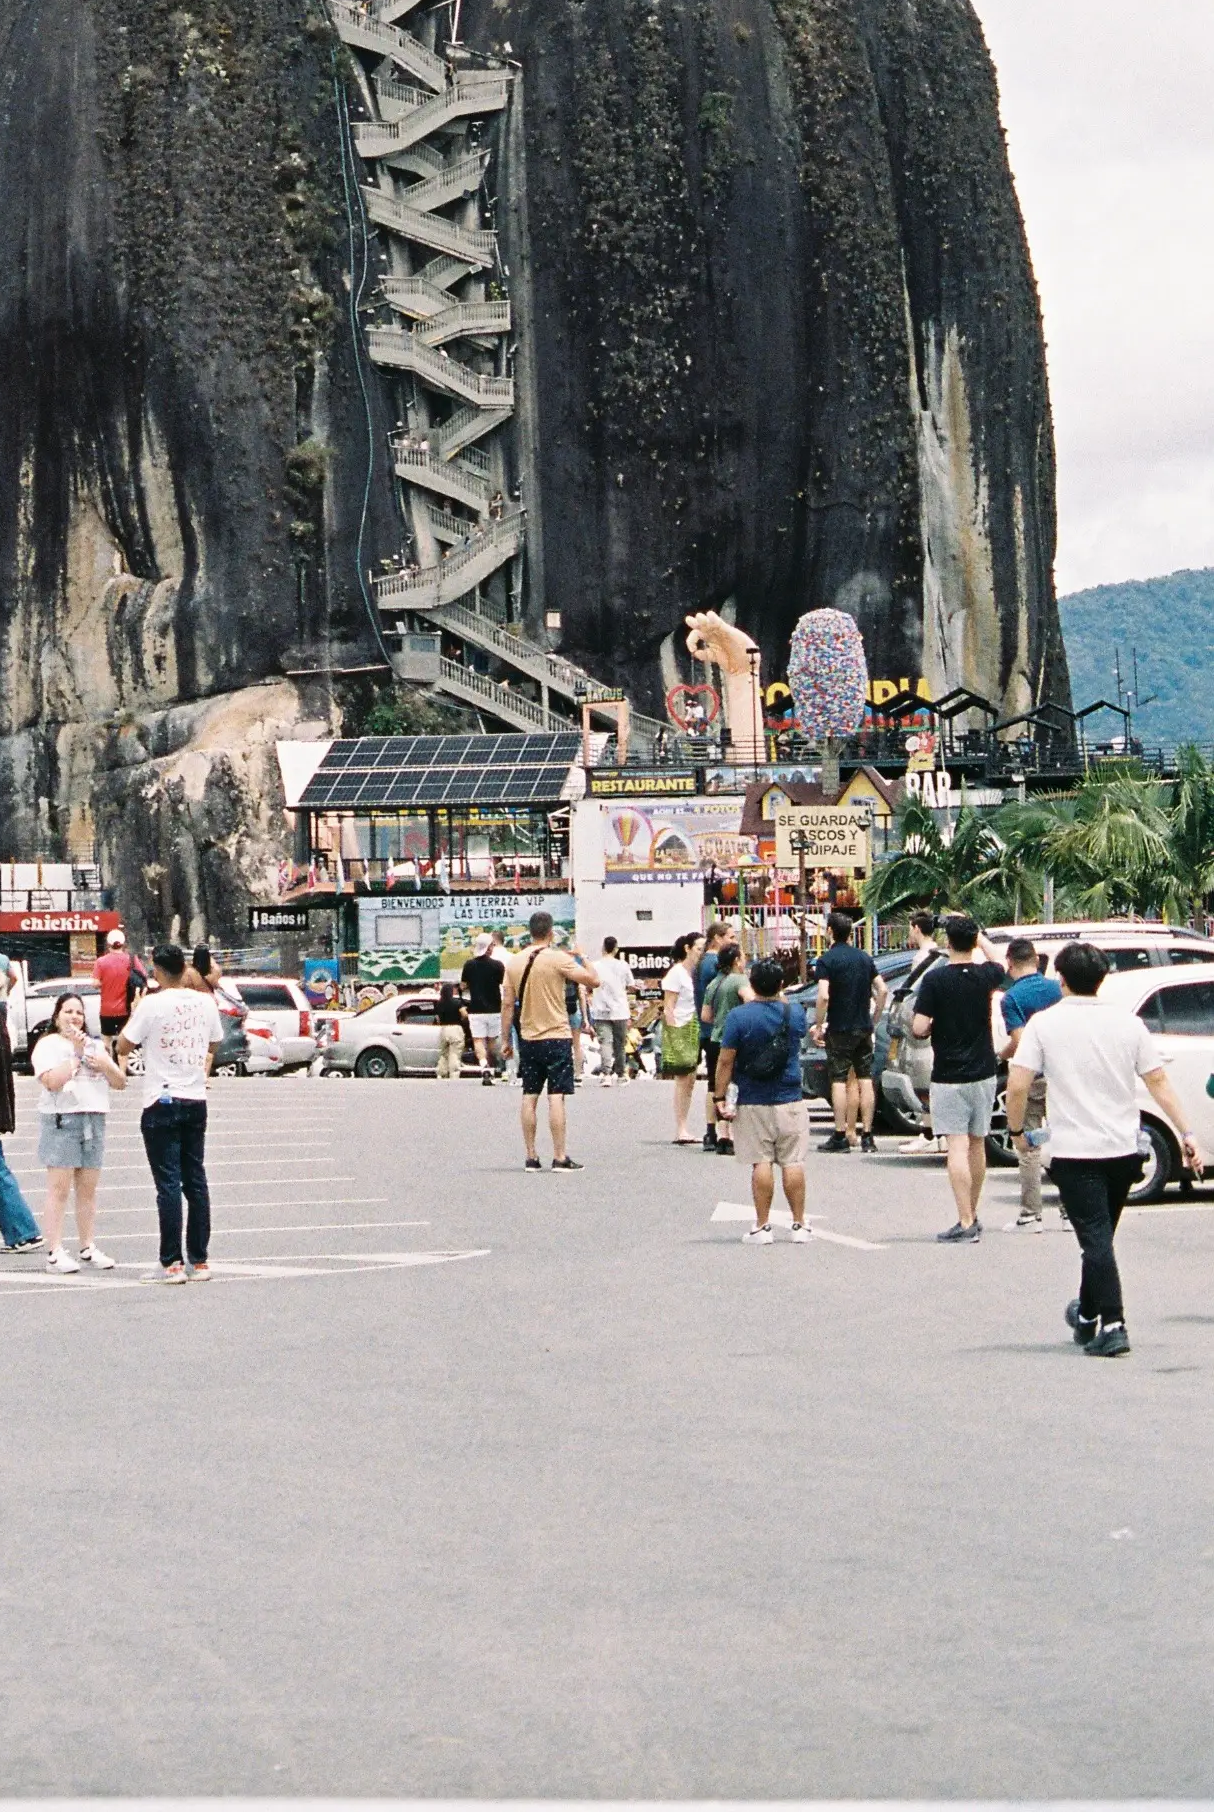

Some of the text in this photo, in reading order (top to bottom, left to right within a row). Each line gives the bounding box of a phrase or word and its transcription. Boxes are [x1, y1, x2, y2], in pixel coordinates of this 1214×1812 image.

[591, 778, 695, 792] RESTAURANTE
[778, 815, 795, 826] SE
[850, 830, 858, 840] Y
[632, 873, 653, 882] QUE
[657, 873, 673, 881] NO
[676, 872, 689, 880] TE
[381, 896, 545, 909] BIENVENIDOS A LA TERRAZA VIP
[260, 912, 295, 925] Baños
[455, 908, 515, 919] LAS LETRAS
[628, 953, 671, 969] Baños
